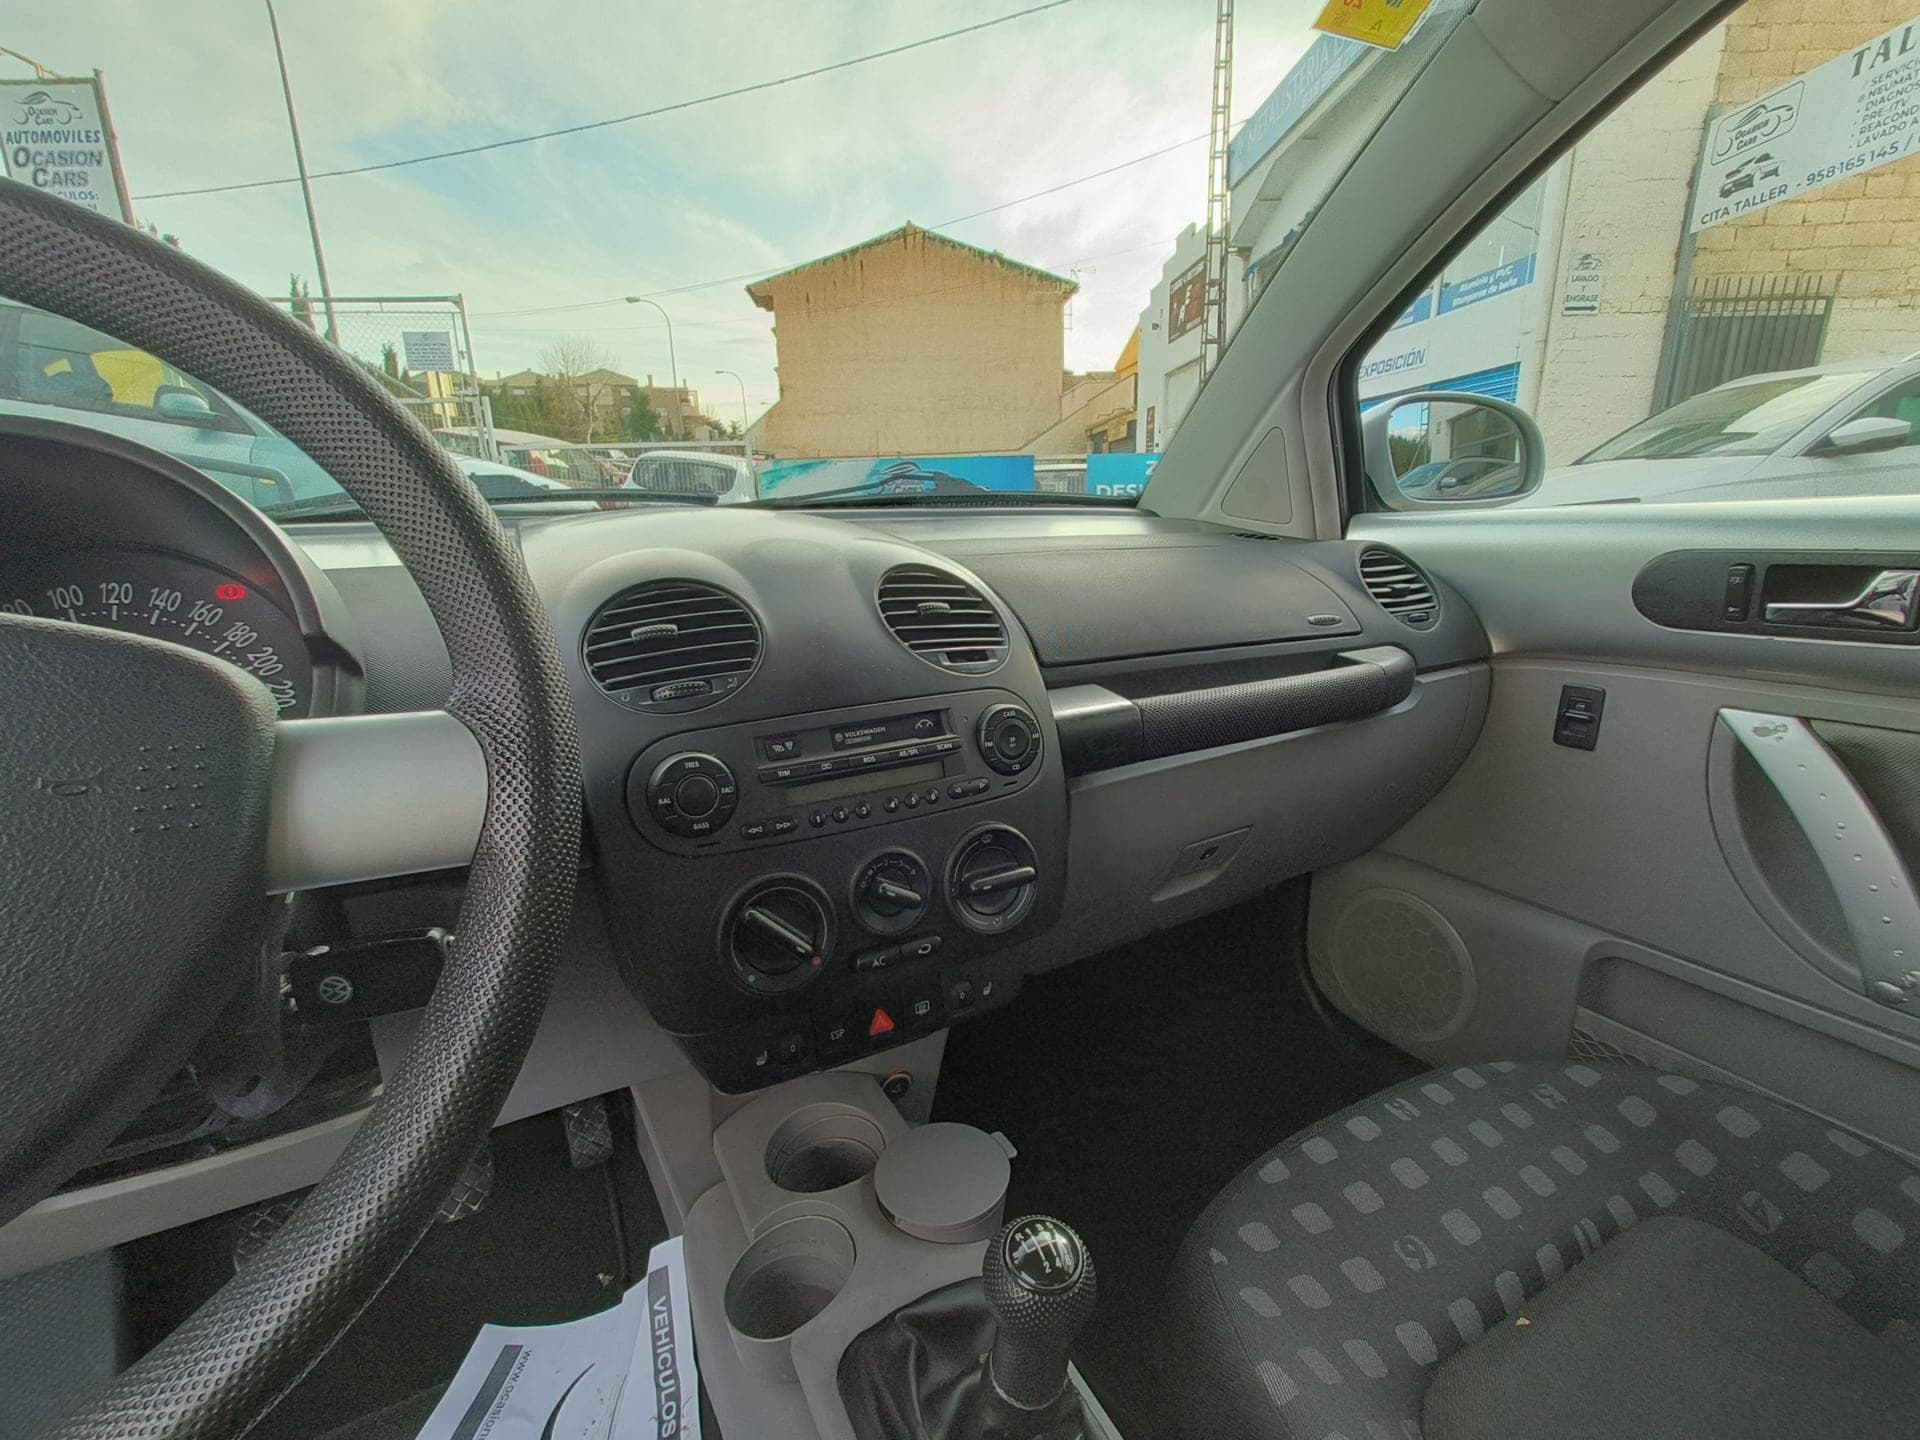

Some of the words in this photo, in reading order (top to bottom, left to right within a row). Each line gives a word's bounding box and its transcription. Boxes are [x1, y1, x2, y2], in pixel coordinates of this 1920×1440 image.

[1871, 57, 1920, 87] SERVICI
[6, 130, 101, 144] AUTOMOVILES
[1857, 121, 1907, 148] LAVADO
[13, 146, 104, 168] OCASION
[33, 168, 89, 188] CARS
[1701, 206, 1730, 225] CITA
[1734, 184, 1788, 213] TALLER
[47, 585, 84, 610] 100
[99, 582, 133, 604] 120
[149, 587, 181, 611] 140
[188, 600, 223, 626] 160
[223, 622, 258, 648] 180
[247, 647, 284, 676] 200
[872, 956, 888, 968] AC
[830, 1028, 845, 1041] ESP
[652, 1296, 678, 1439] VEHÍCULOS
